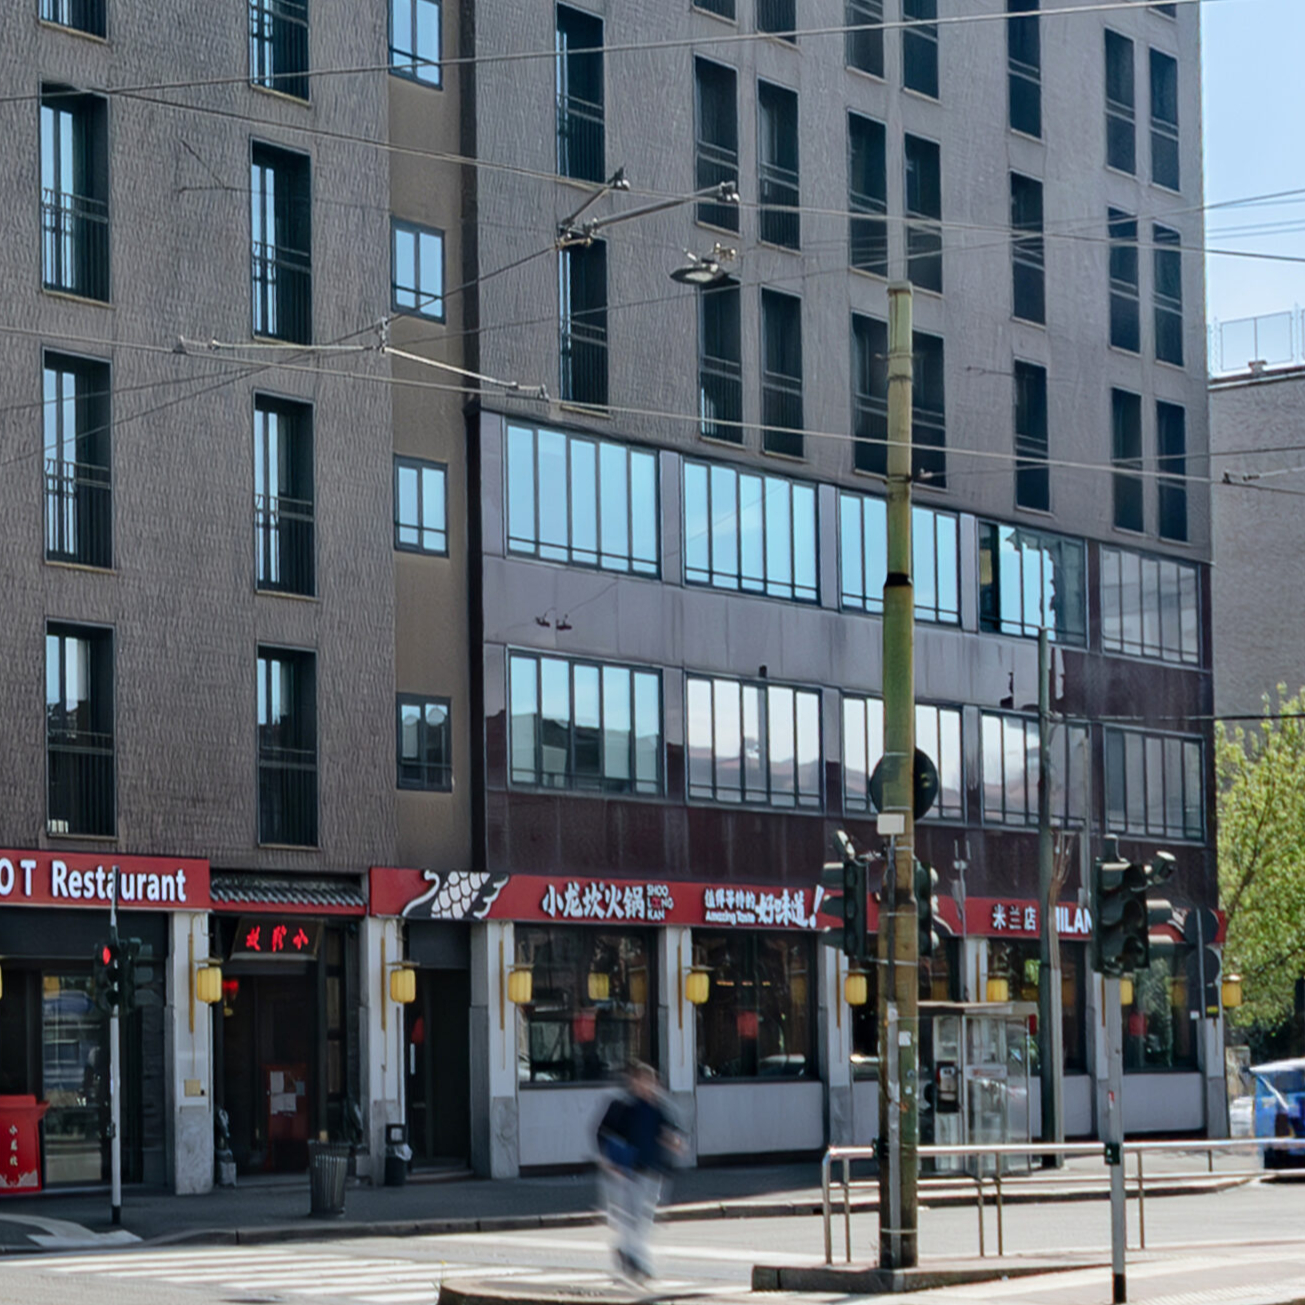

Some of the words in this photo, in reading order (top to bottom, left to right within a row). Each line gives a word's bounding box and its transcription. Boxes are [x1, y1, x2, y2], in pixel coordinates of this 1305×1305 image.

[992, 903, 1036, 931] 米兰店
[1055, 906, 1093, 934] ILAN
